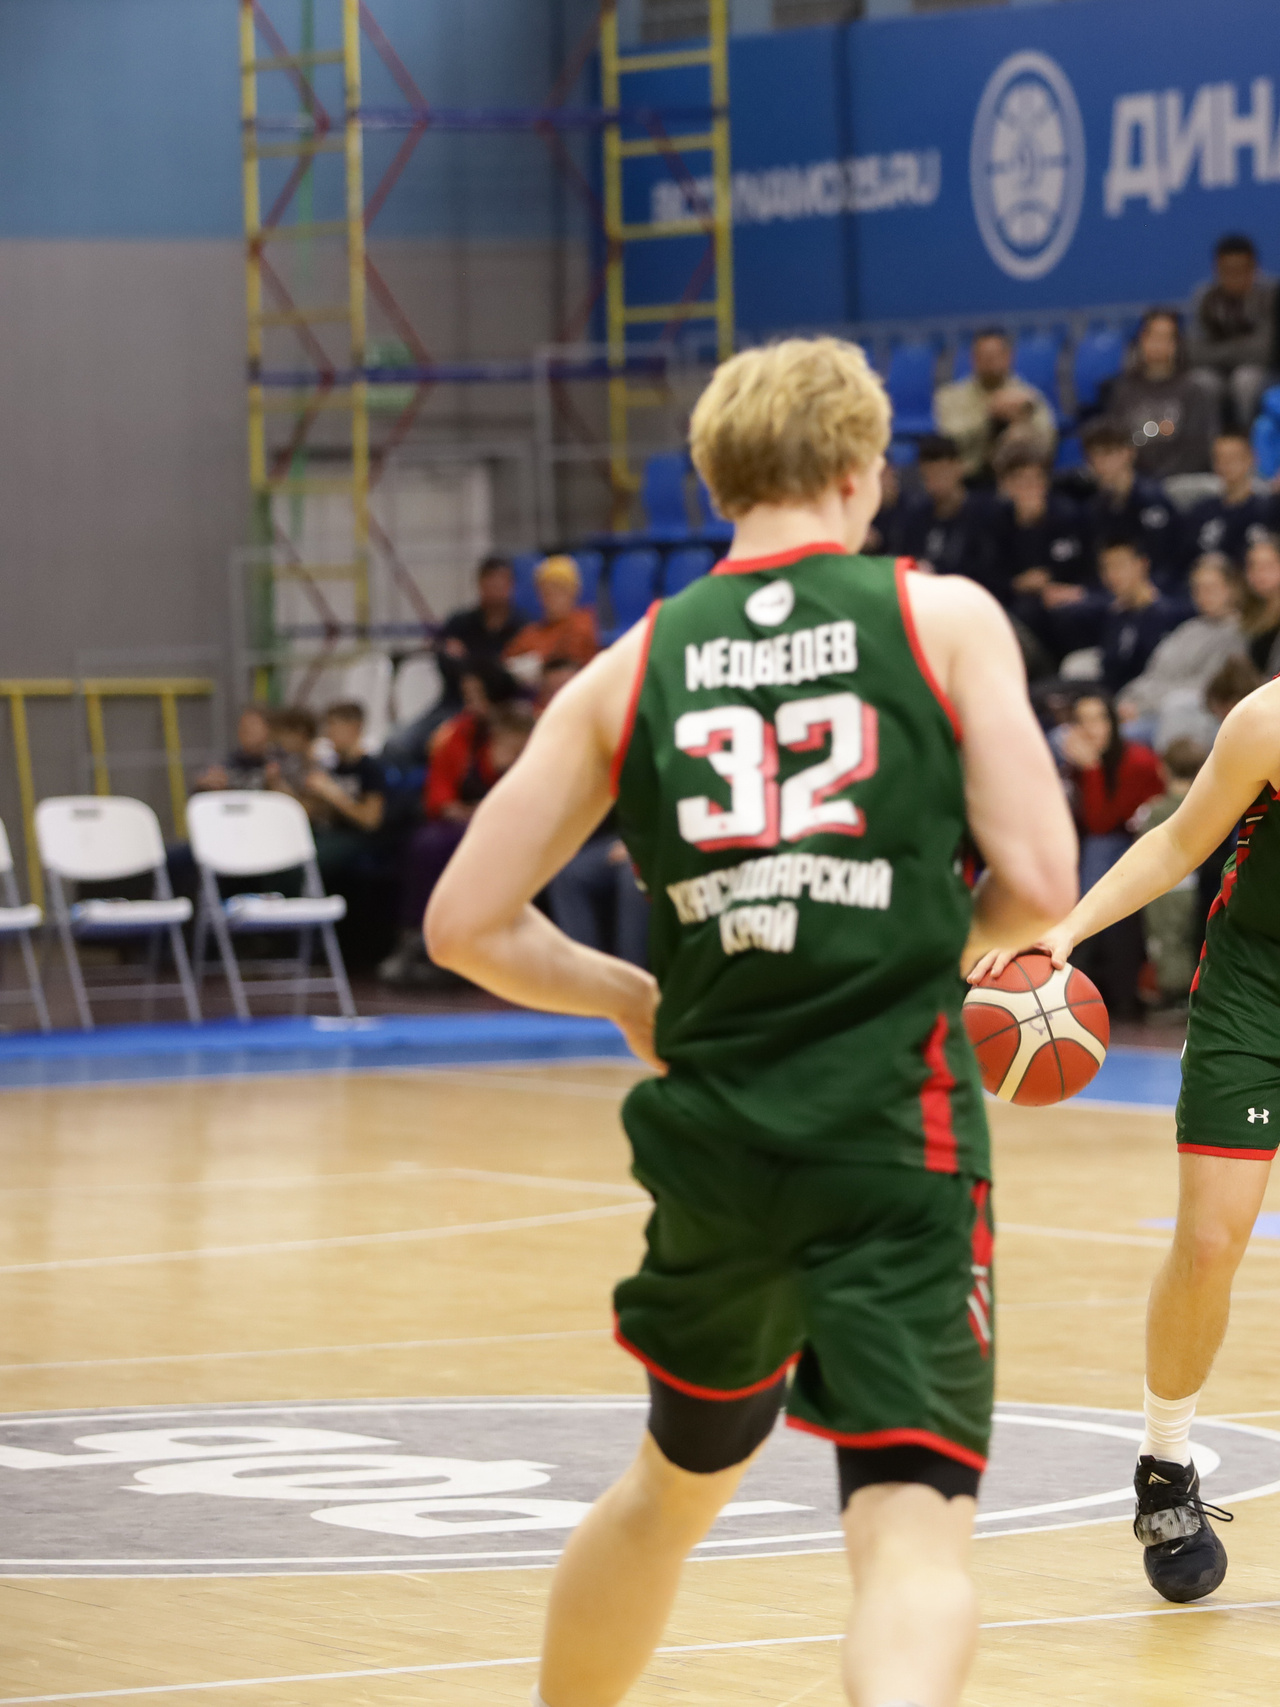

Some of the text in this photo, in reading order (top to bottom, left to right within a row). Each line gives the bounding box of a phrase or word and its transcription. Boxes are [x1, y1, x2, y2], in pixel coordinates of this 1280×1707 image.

[685, 620, 858, 691] МЕДВЕДЕВ
[675, 692, 879, 852] 32
[719, 900, 799, 956] КРАЙ
